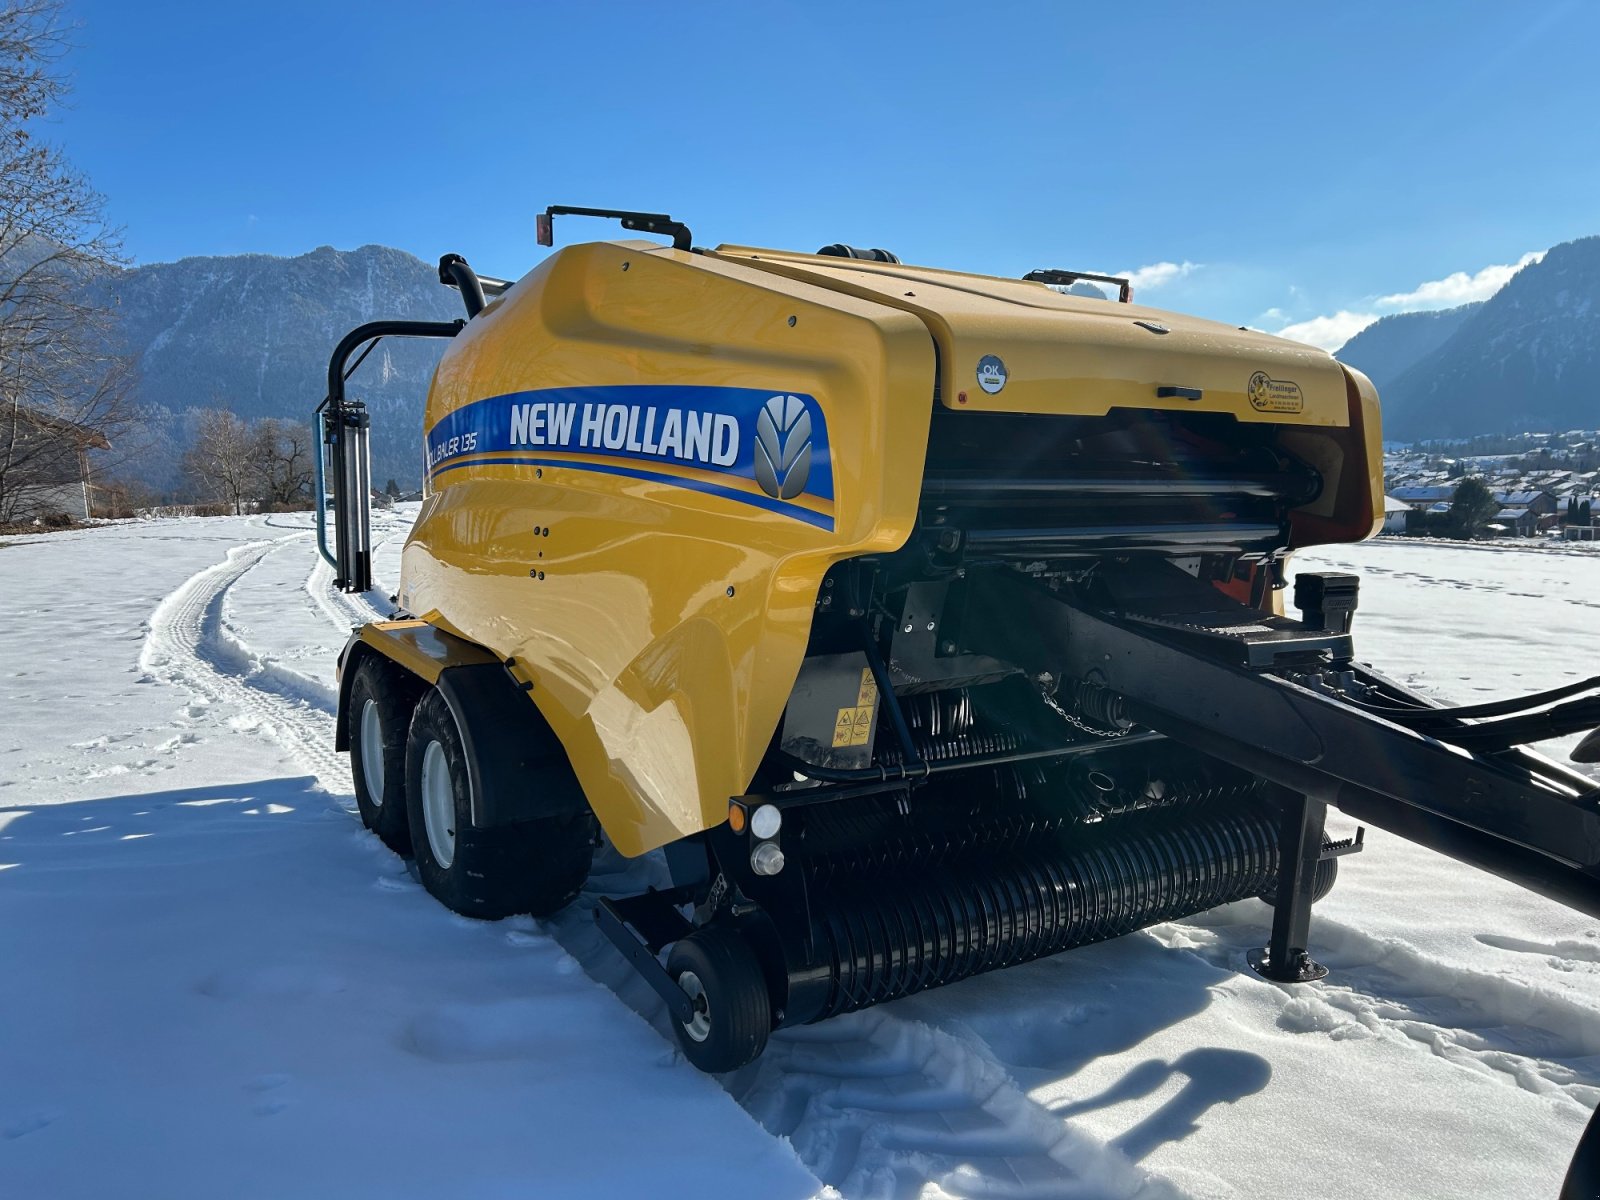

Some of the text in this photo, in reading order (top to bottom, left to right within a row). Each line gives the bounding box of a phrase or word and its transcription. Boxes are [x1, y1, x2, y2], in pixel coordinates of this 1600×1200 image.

[983, 364, 999, 376] OK
[461, 432, 478, 452] 135
[509, 402, 740, 467] NEW HOLLAND
